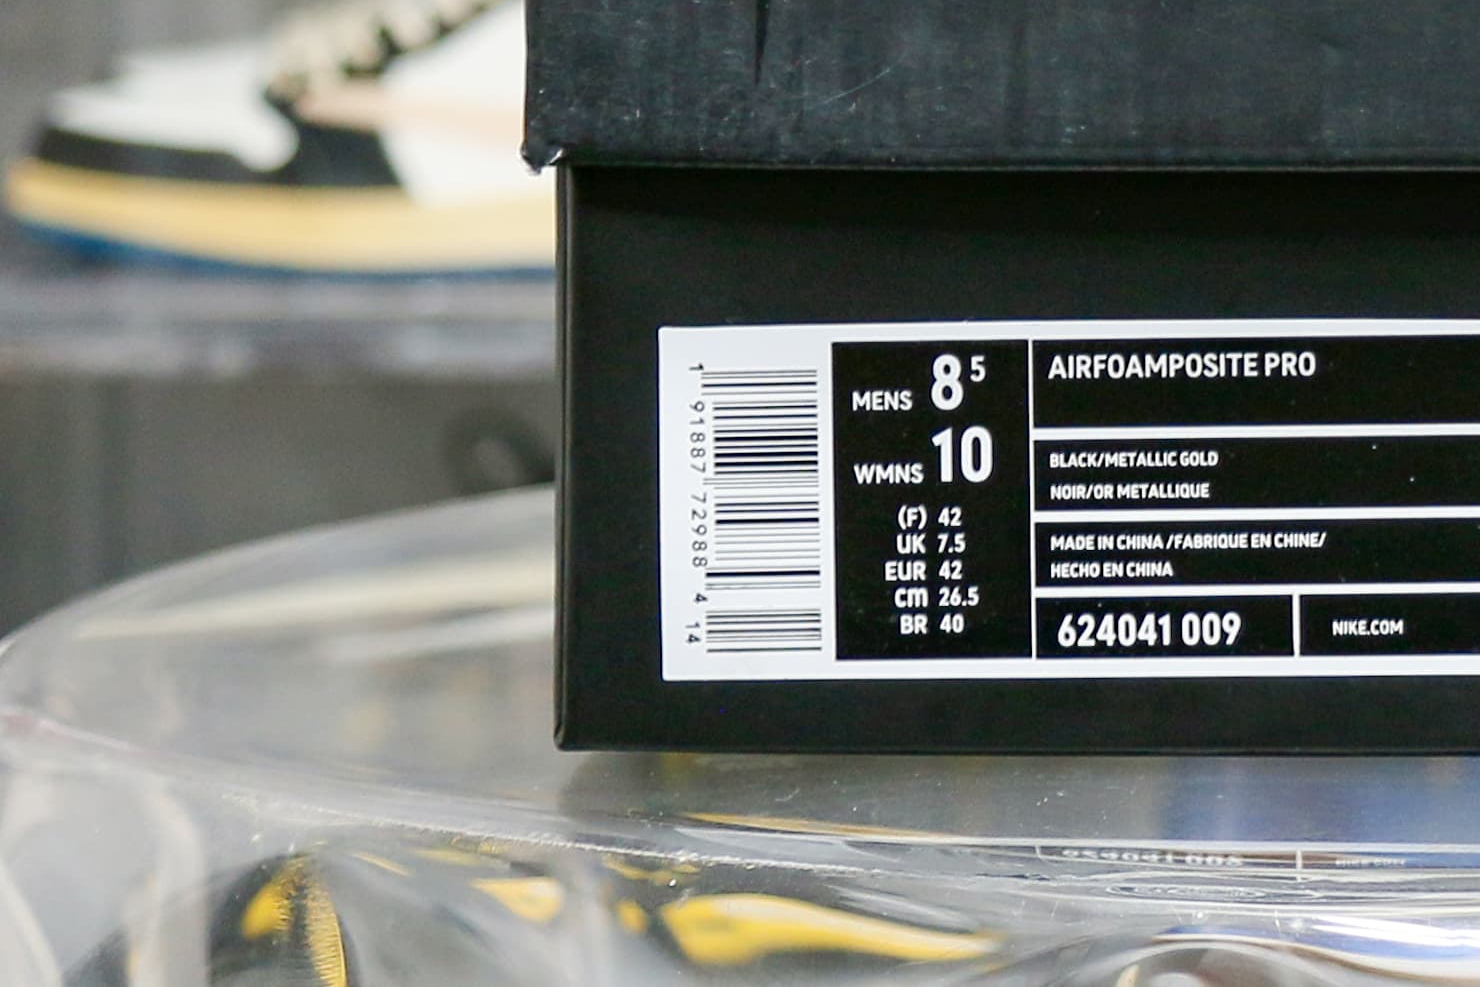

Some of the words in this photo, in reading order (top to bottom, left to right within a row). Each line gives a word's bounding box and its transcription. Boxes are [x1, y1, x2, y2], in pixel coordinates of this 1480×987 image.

[1048, 352, 1258, 379] AIRFOAMPOSITE
[1265, 351, 1316, 377] PRO
[853, 390, 912, 412] MENS
[854, 463, 924, 485] WMNS
[932, 426, 992, 482] 10
[1050, 451, 1177, 468] BLACK/METALLIC
[1180, 451, 1218, 467] GOLD
[1051, 484, 1113, 501] NOIR/OR
[1117, 483, 1210, 500] METALLIQUE
[898, 505, 927, 530] (F)
[938, 507, 962, 526] 42
[896, 533, 926, 554] UK
[938, 533, 966, 553] 7.5
[1051, 535, 1095, 551] MADE
[1098, 535, 1114, 551] IN
[1117, 534, 1164, 551] CHINA
[1166, 532, 1248, 550] /FABRIQUE
[1251, 533, 1272, 549] EN
[1274, 531, 1326, 548] CHINE/
[885, 560, 926, 581] EUR
[939, 560, 962, 580] 42
[1051, 562, 1100, 578] HECHO
[1103, 562, 1124, 578] EN
[1126, 561, 1173, 577] CHINA
[939, 586, 979, 607] 26.5
[900, 614, 928, 634] BR
[940, 613, 964, 633] 40
[1058, 612, 1171, 647] 624041
[1182, 612, 1241, 647] 009
[1332, 619, 1404, 636] NIKE.COM
